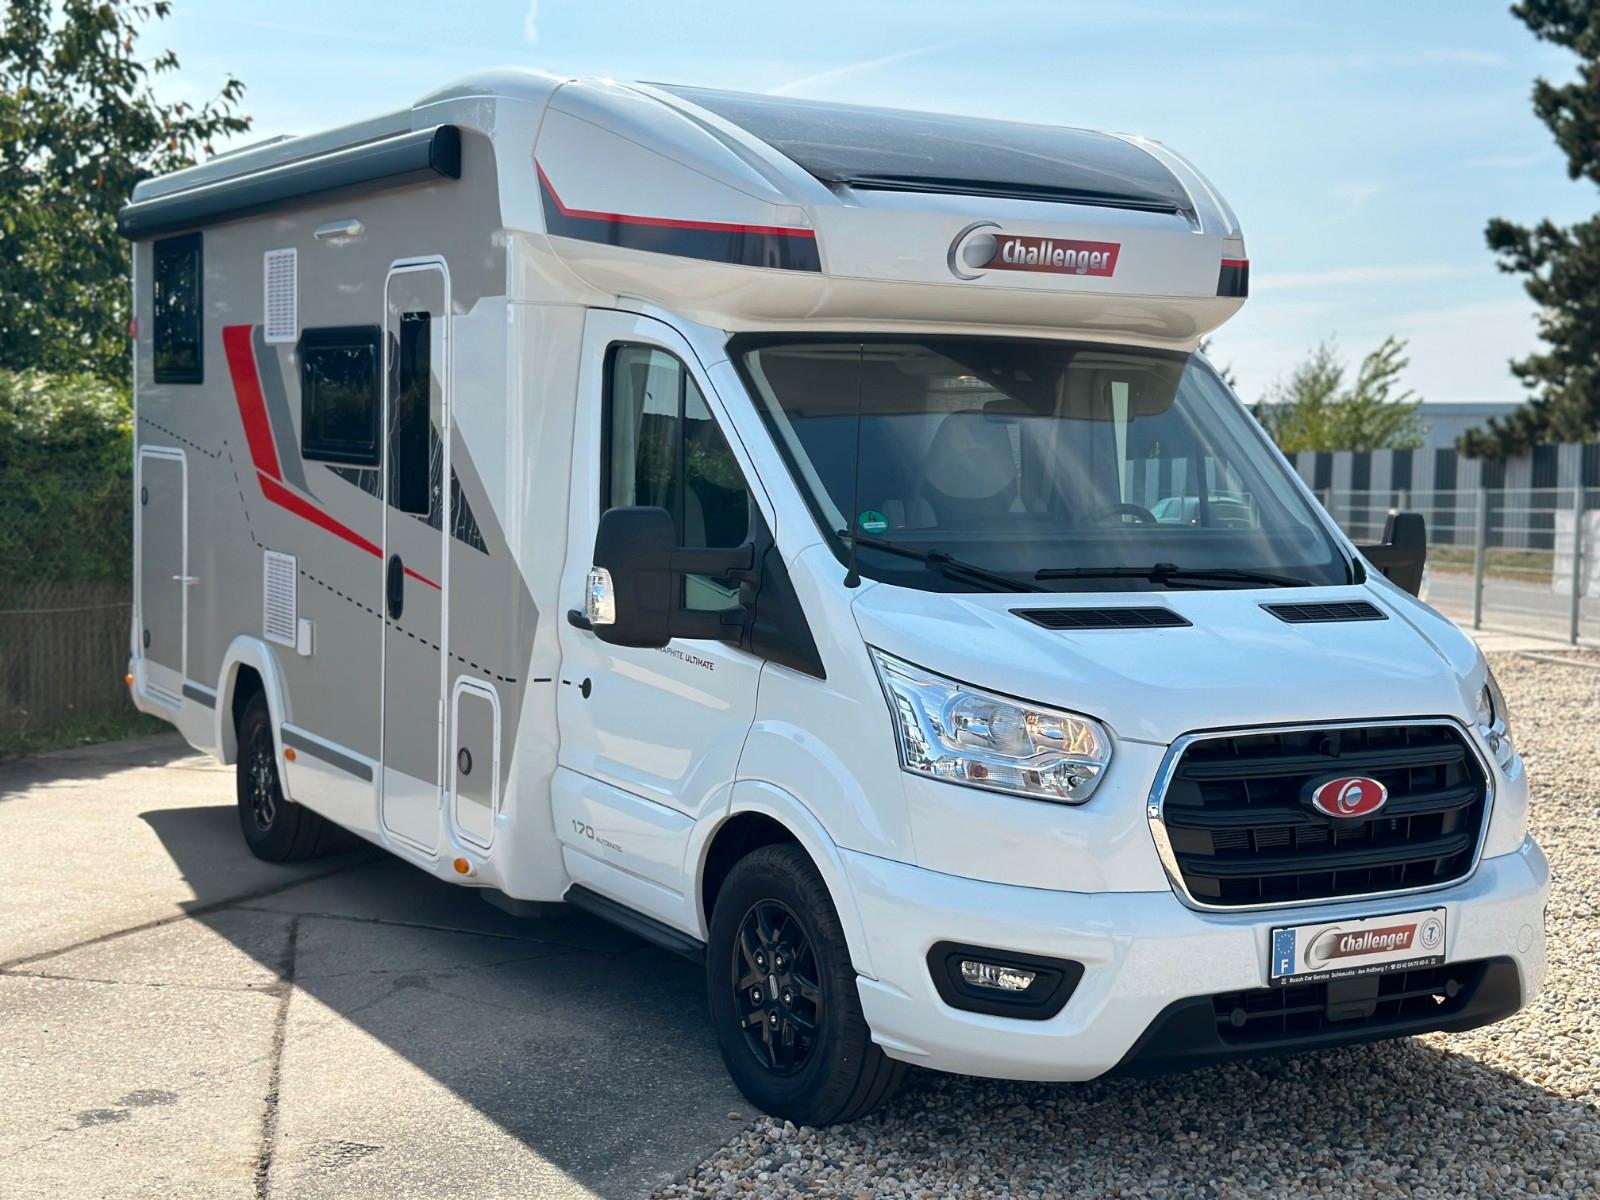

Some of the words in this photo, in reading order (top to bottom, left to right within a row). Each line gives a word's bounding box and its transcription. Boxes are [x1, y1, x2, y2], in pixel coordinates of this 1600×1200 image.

[1002, 239, 1110, 274] Challenger
[685, 653, 715, 670] ULTIMATE
[572, 819, 595, 839] 170
[1340, 931, 1409, 952] Challenger
[1281, 959, 1289, 974] F
